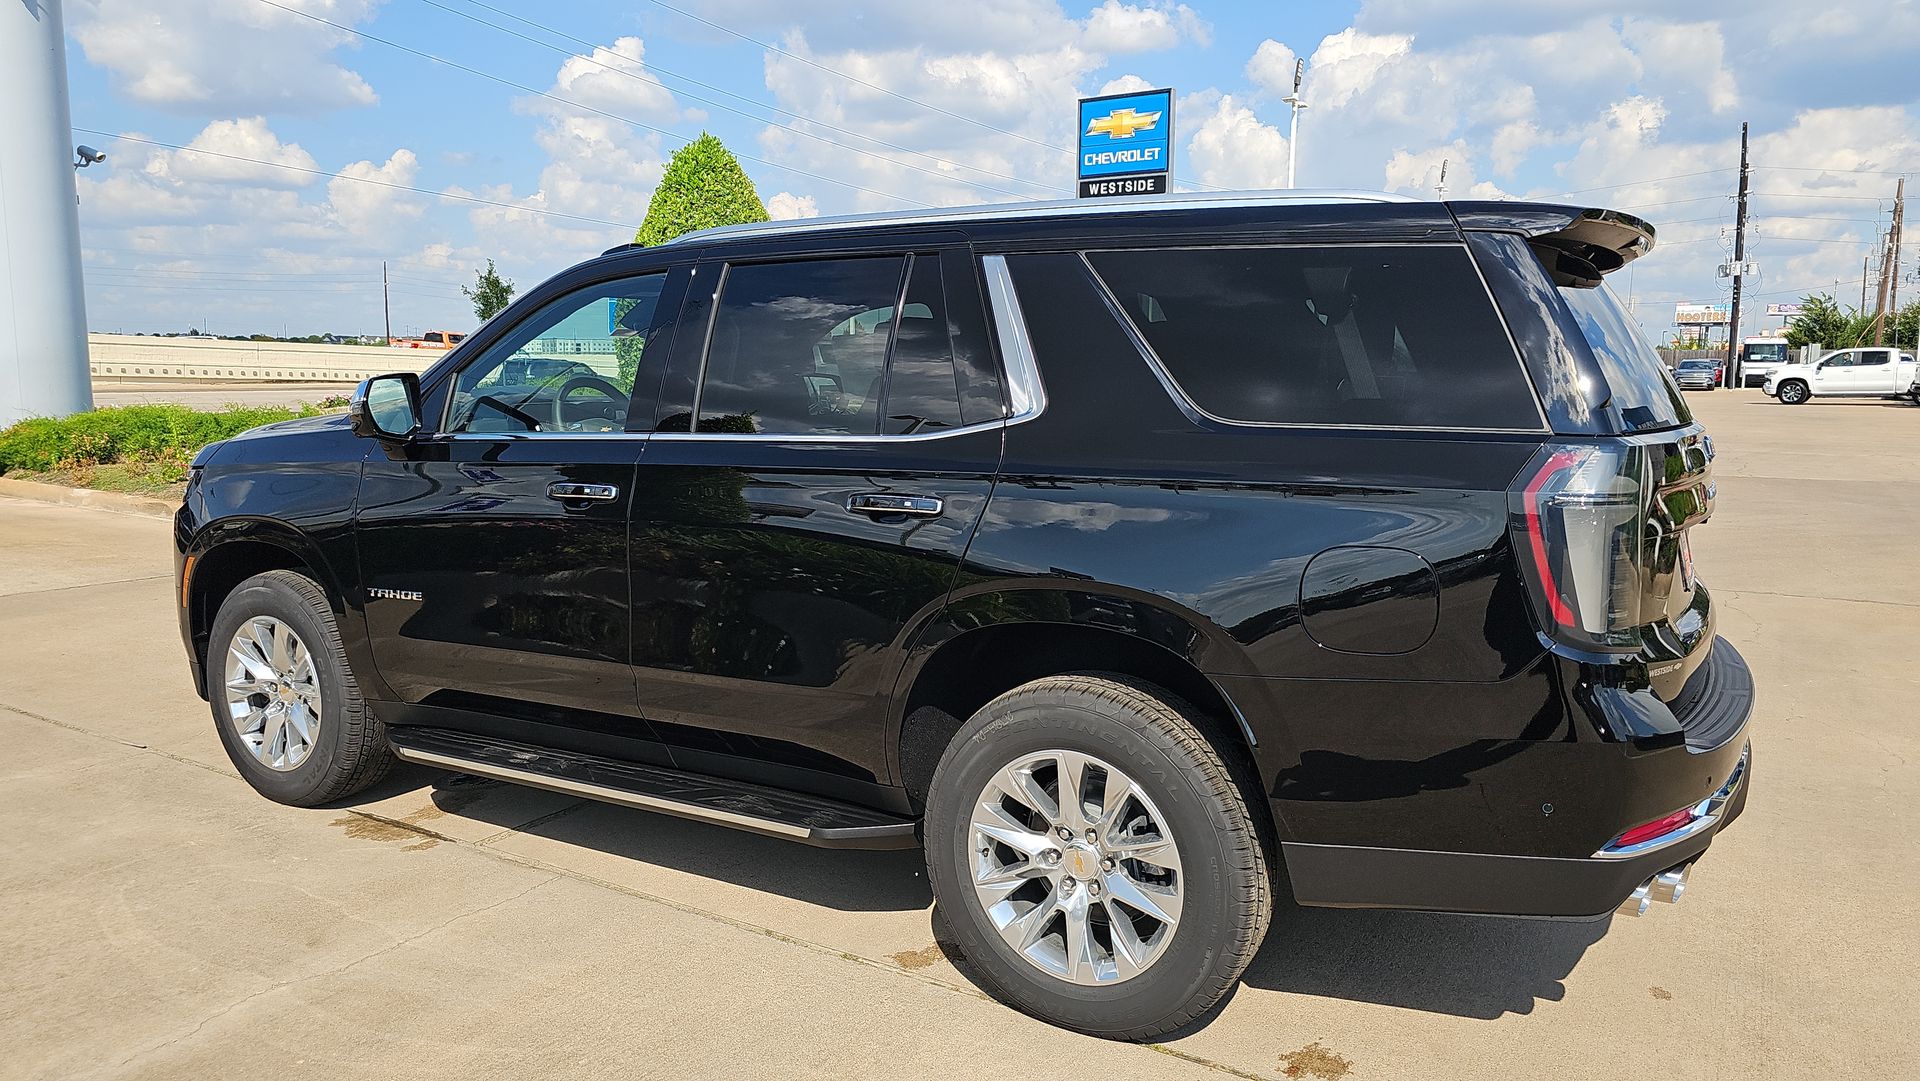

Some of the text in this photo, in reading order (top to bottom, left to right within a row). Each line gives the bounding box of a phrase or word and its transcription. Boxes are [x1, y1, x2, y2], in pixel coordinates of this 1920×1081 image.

[1084, 147, 1161, 166] CHEVROLET
[1088, 179, 1155, 195] WESTSIDE
[366, 587, 423, 601] TAHOE
[1649, 664, 1674, 678] WESTSIDE
